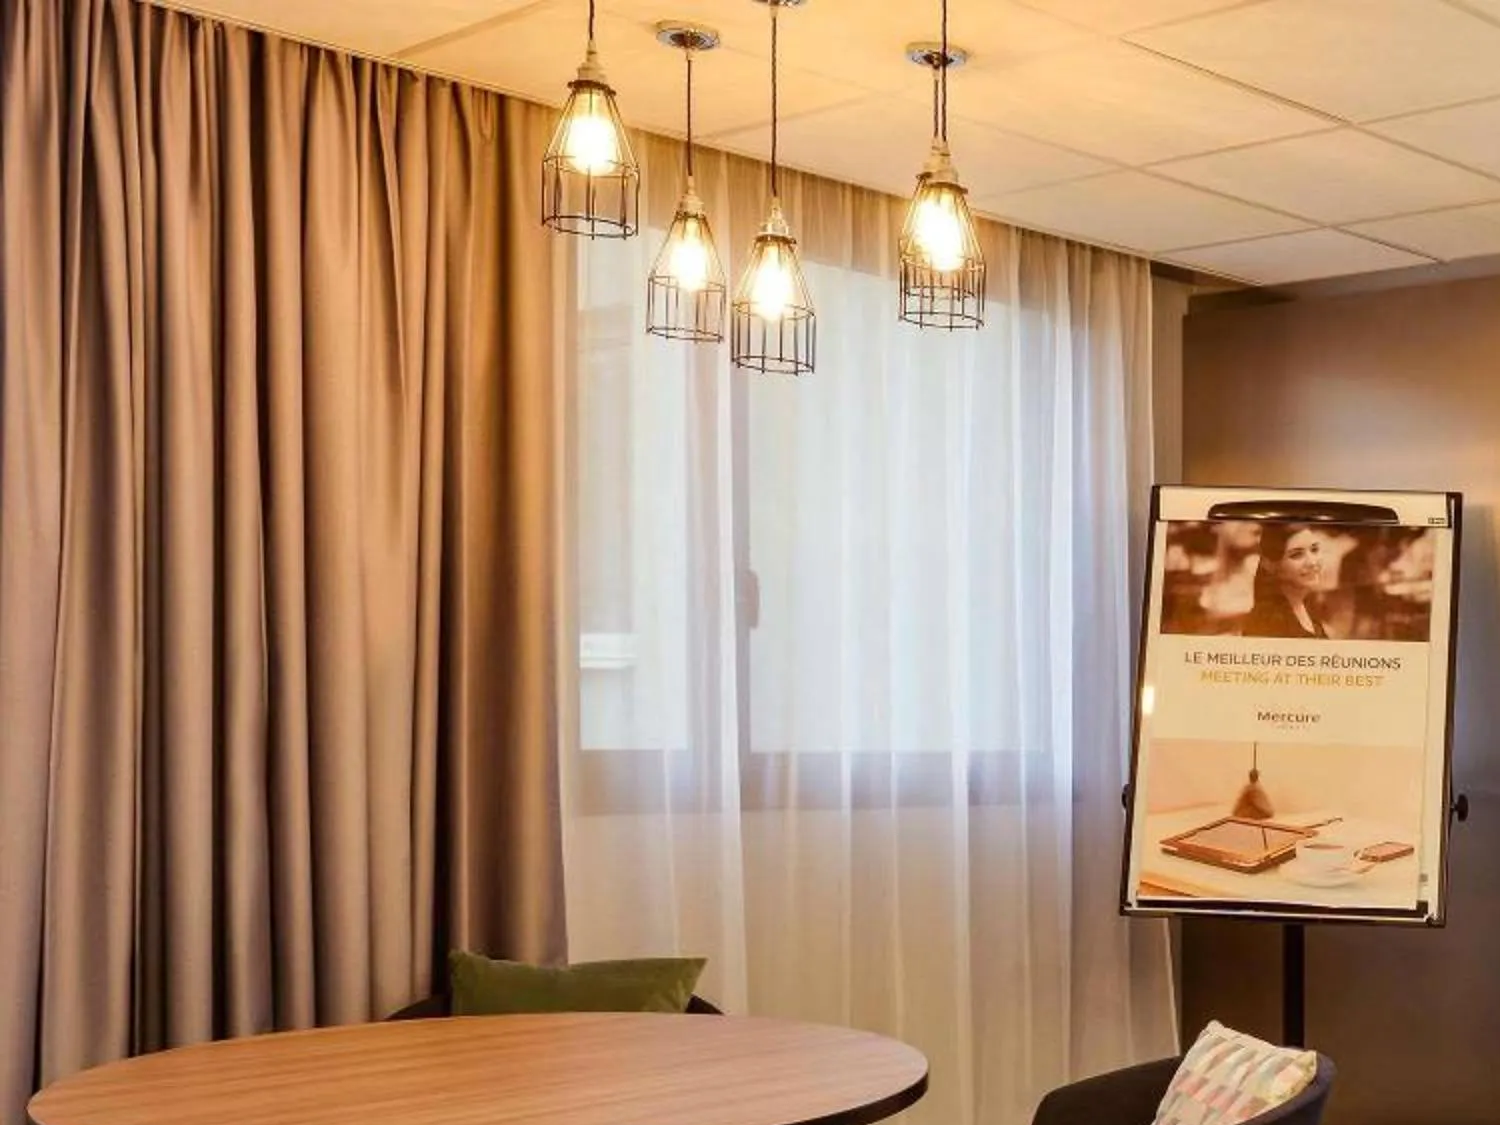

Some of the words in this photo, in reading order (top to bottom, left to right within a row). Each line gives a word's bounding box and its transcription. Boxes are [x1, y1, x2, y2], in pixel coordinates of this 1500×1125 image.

[1184, 651, 1201, 664] LE
[1207, 653, 1283, 667] MEILLEUR
[1286, 655, 1316, 668] DES
[1320, 653, 1402, 670] RÉUNIONS
[1200, 670, 1269, 685] MEETING
[1273, 672, 1290, 685] AT
[1298, 673, 1341, 687] THEIR
[1345, 675, 1385, 688] BEST
[1256, 711, 1321, 724] Mercure
